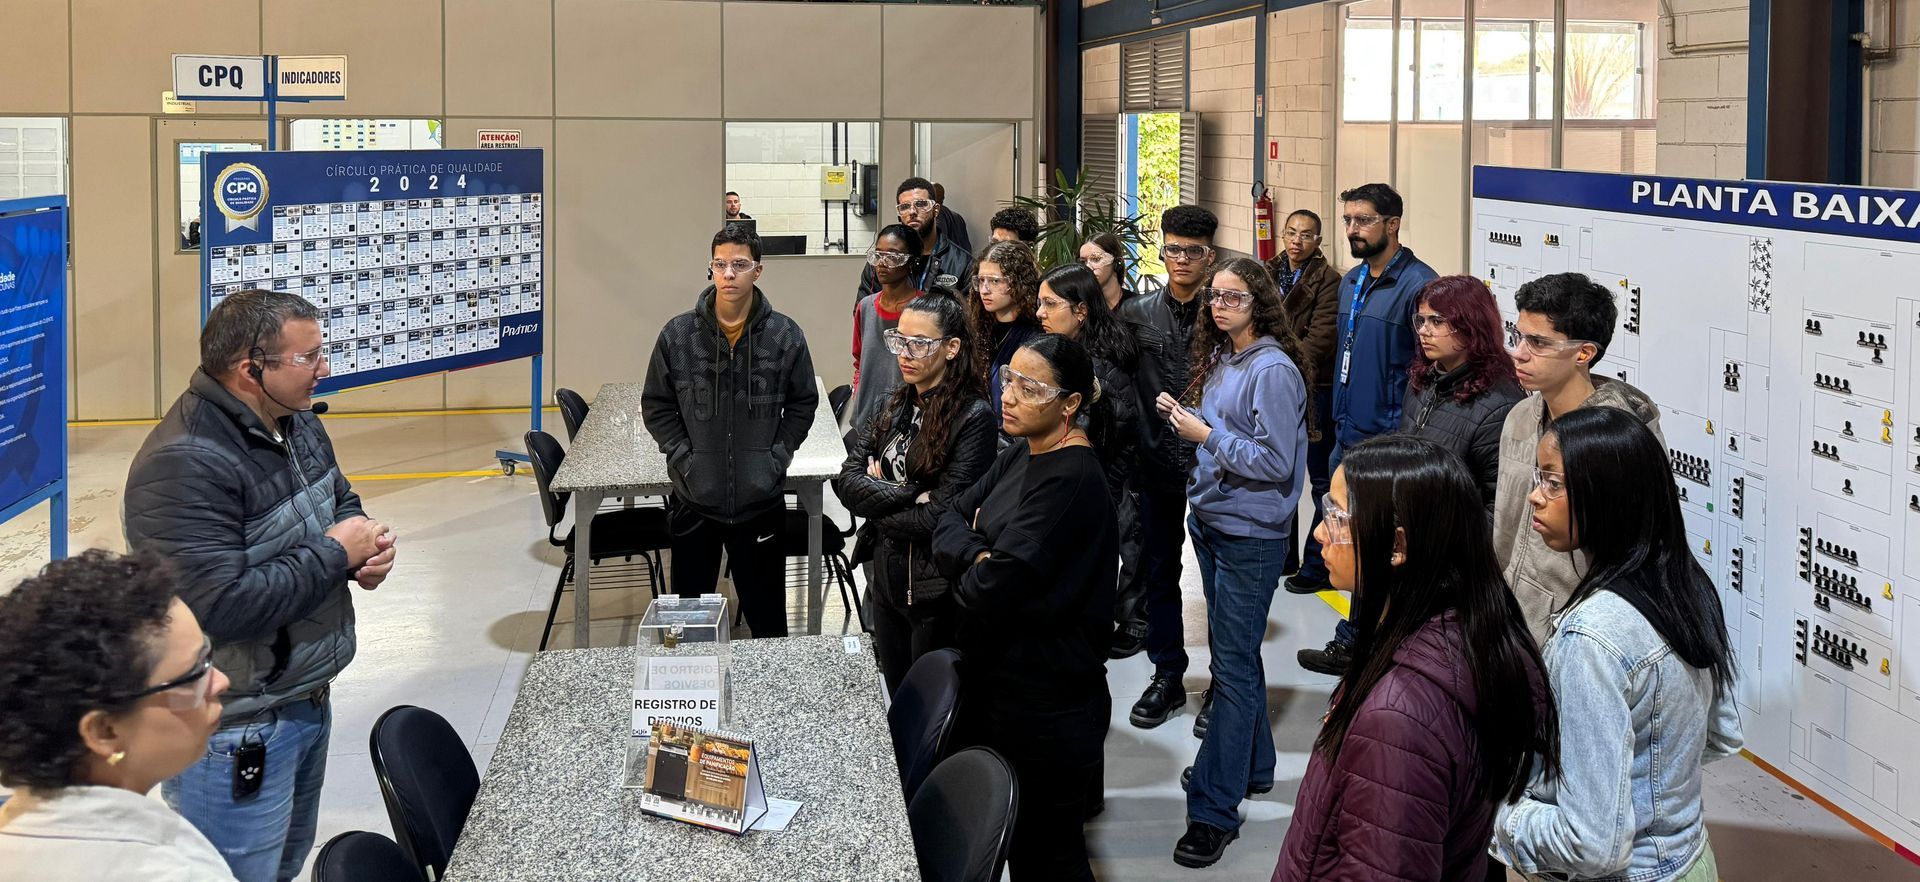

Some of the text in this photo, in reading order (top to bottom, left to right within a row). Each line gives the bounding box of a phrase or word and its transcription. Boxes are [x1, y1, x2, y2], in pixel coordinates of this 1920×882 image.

[199, 65, 243, 90] CPQ
[281, 71, 341, 84] INDICADORES
[481, 133, 519, 142] ATENÇÃO!
[326, 162, 503, 177] CÍRCULO PRÁTICA DE QUALIDADE
[226, 182, 257, 194] CPQ
[1632, 180, 1778, 216] PLANTA
[634, 699, 717, 710] REGISTRO DE
[701, 753, 735, 765] EQUIPAMENTOS
[705, 760, 736, 771] PANIFICAÇÃO
